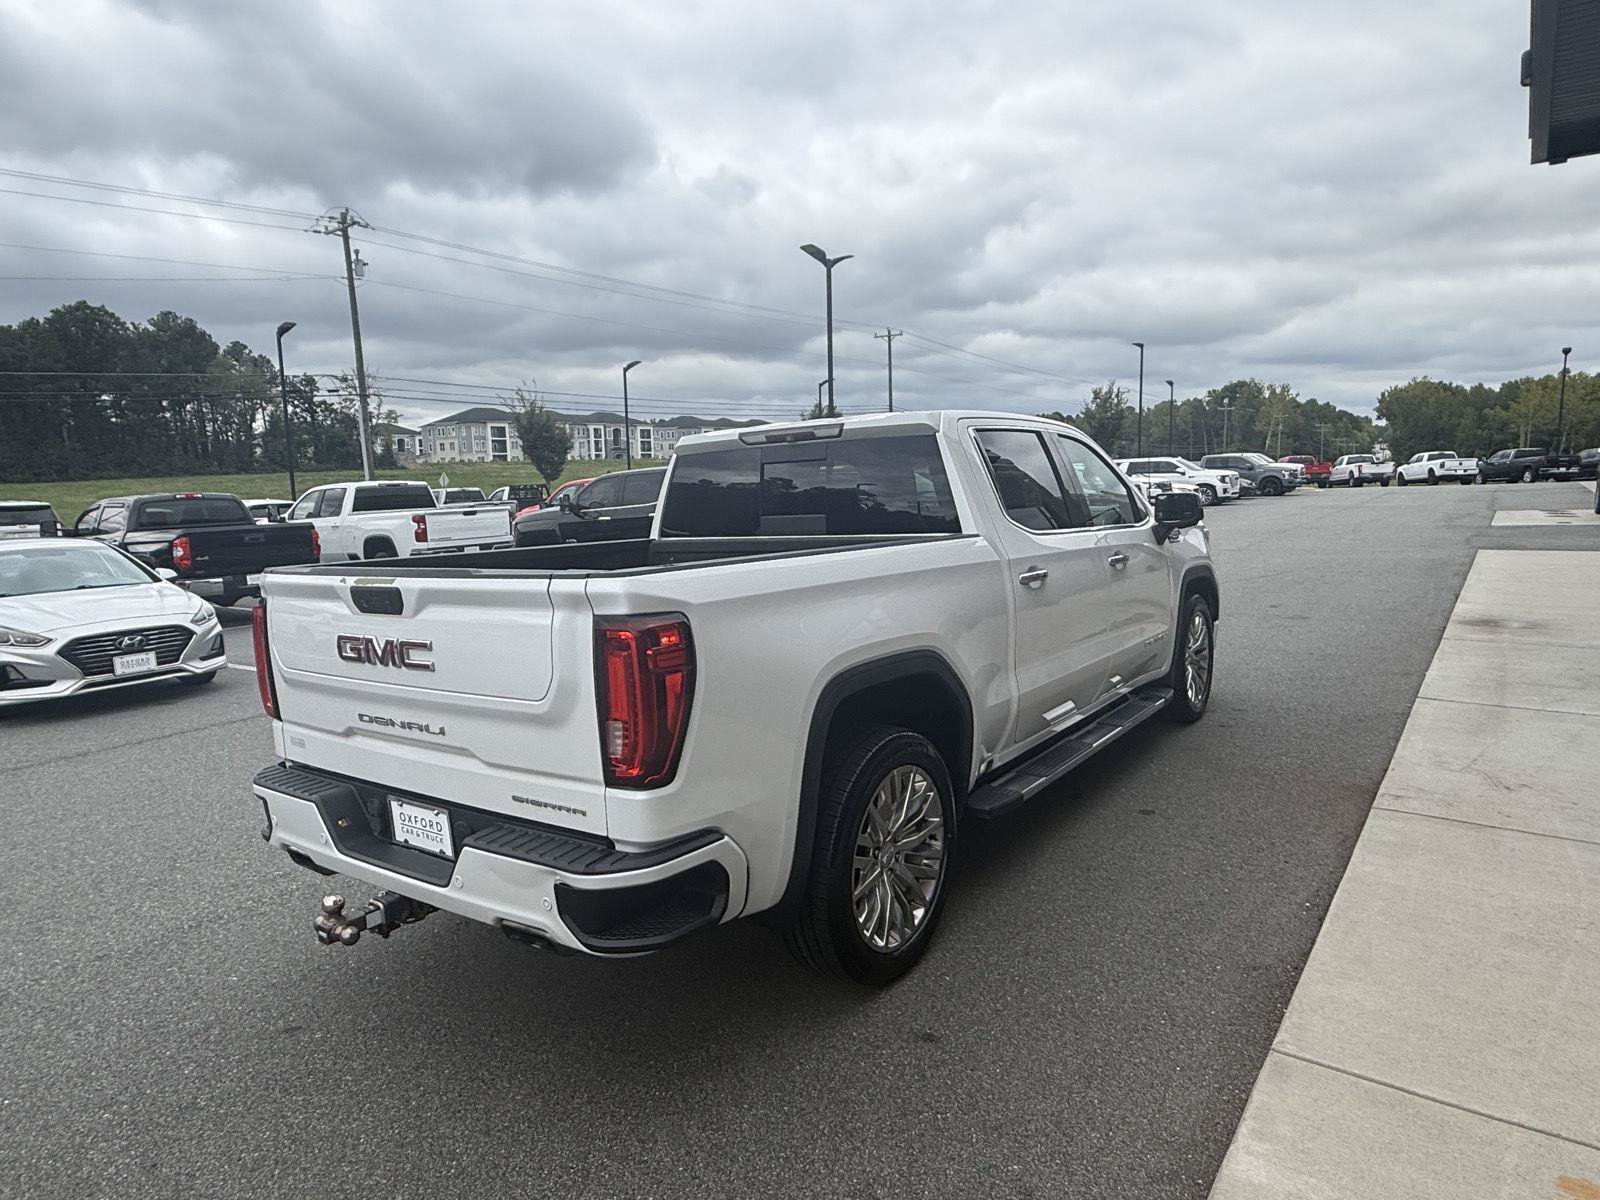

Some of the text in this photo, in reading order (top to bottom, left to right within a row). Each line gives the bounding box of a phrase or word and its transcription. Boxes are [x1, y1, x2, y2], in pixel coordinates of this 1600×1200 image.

[337, 633, 435, 672] GMC
[358, 713, 446, 736] DENALI
[511, 795, 587, 816] SIERRA
[399, 812, 443, 832] OXFORD
[401, 826, 445, 845] CAR & TRUCK
